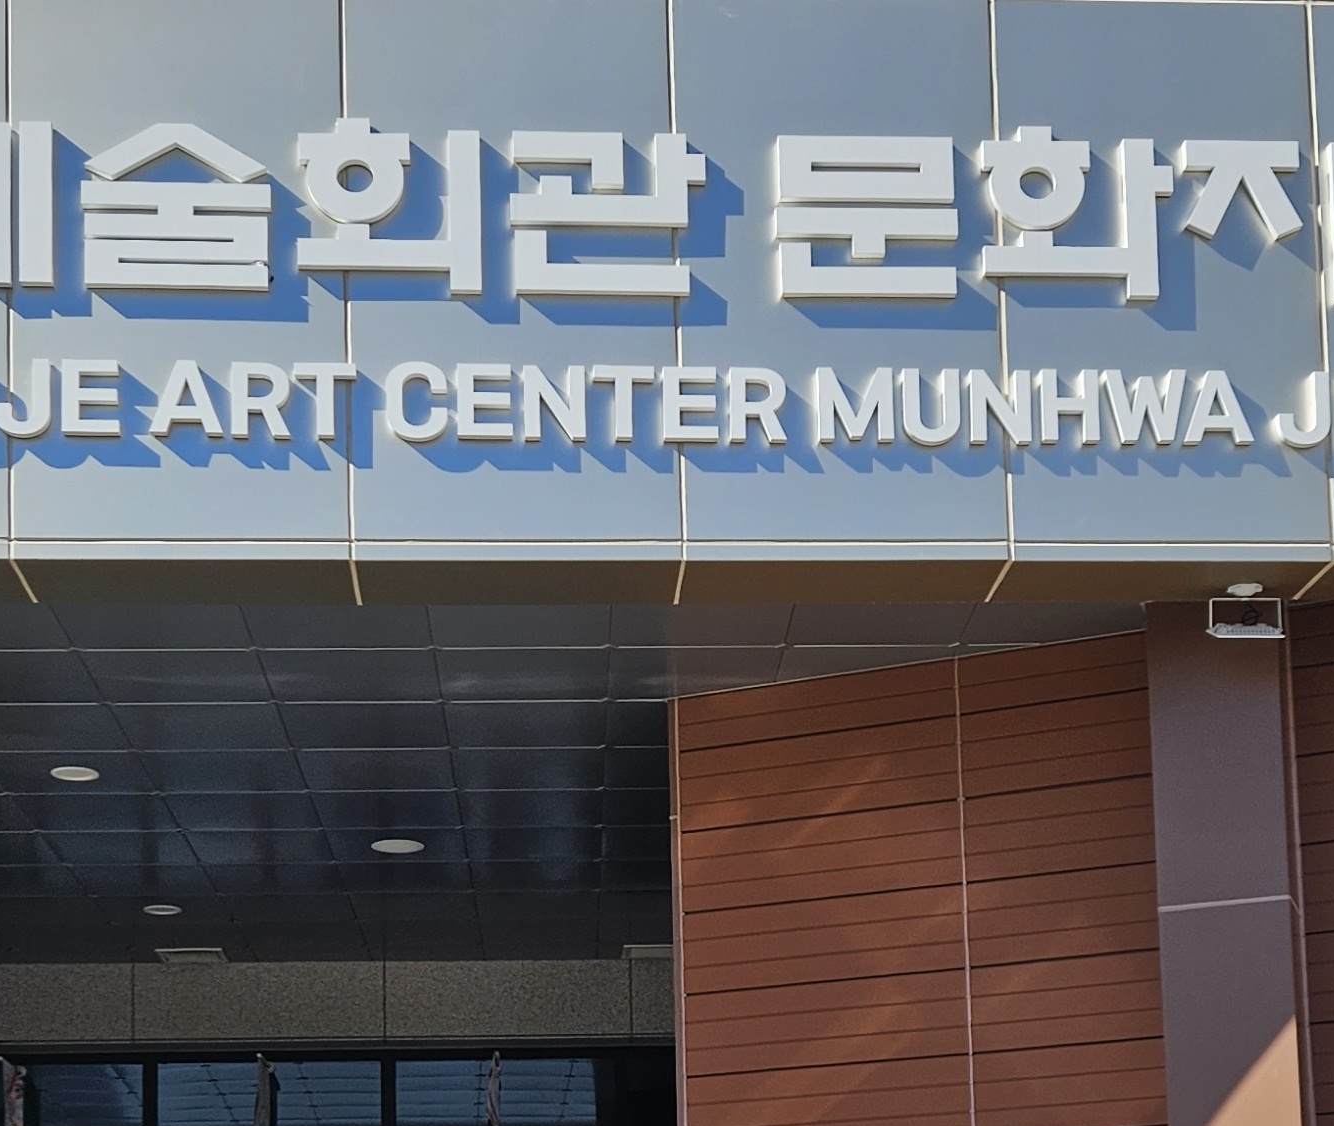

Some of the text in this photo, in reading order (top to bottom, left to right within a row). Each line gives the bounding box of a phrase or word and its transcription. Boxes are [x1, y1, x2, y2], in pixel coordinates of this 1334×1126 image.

[150, 358, 359, 443] ART
[383, 358, 788, 448] CENTER
[815, 366, 1253, 450] MUNHWA
